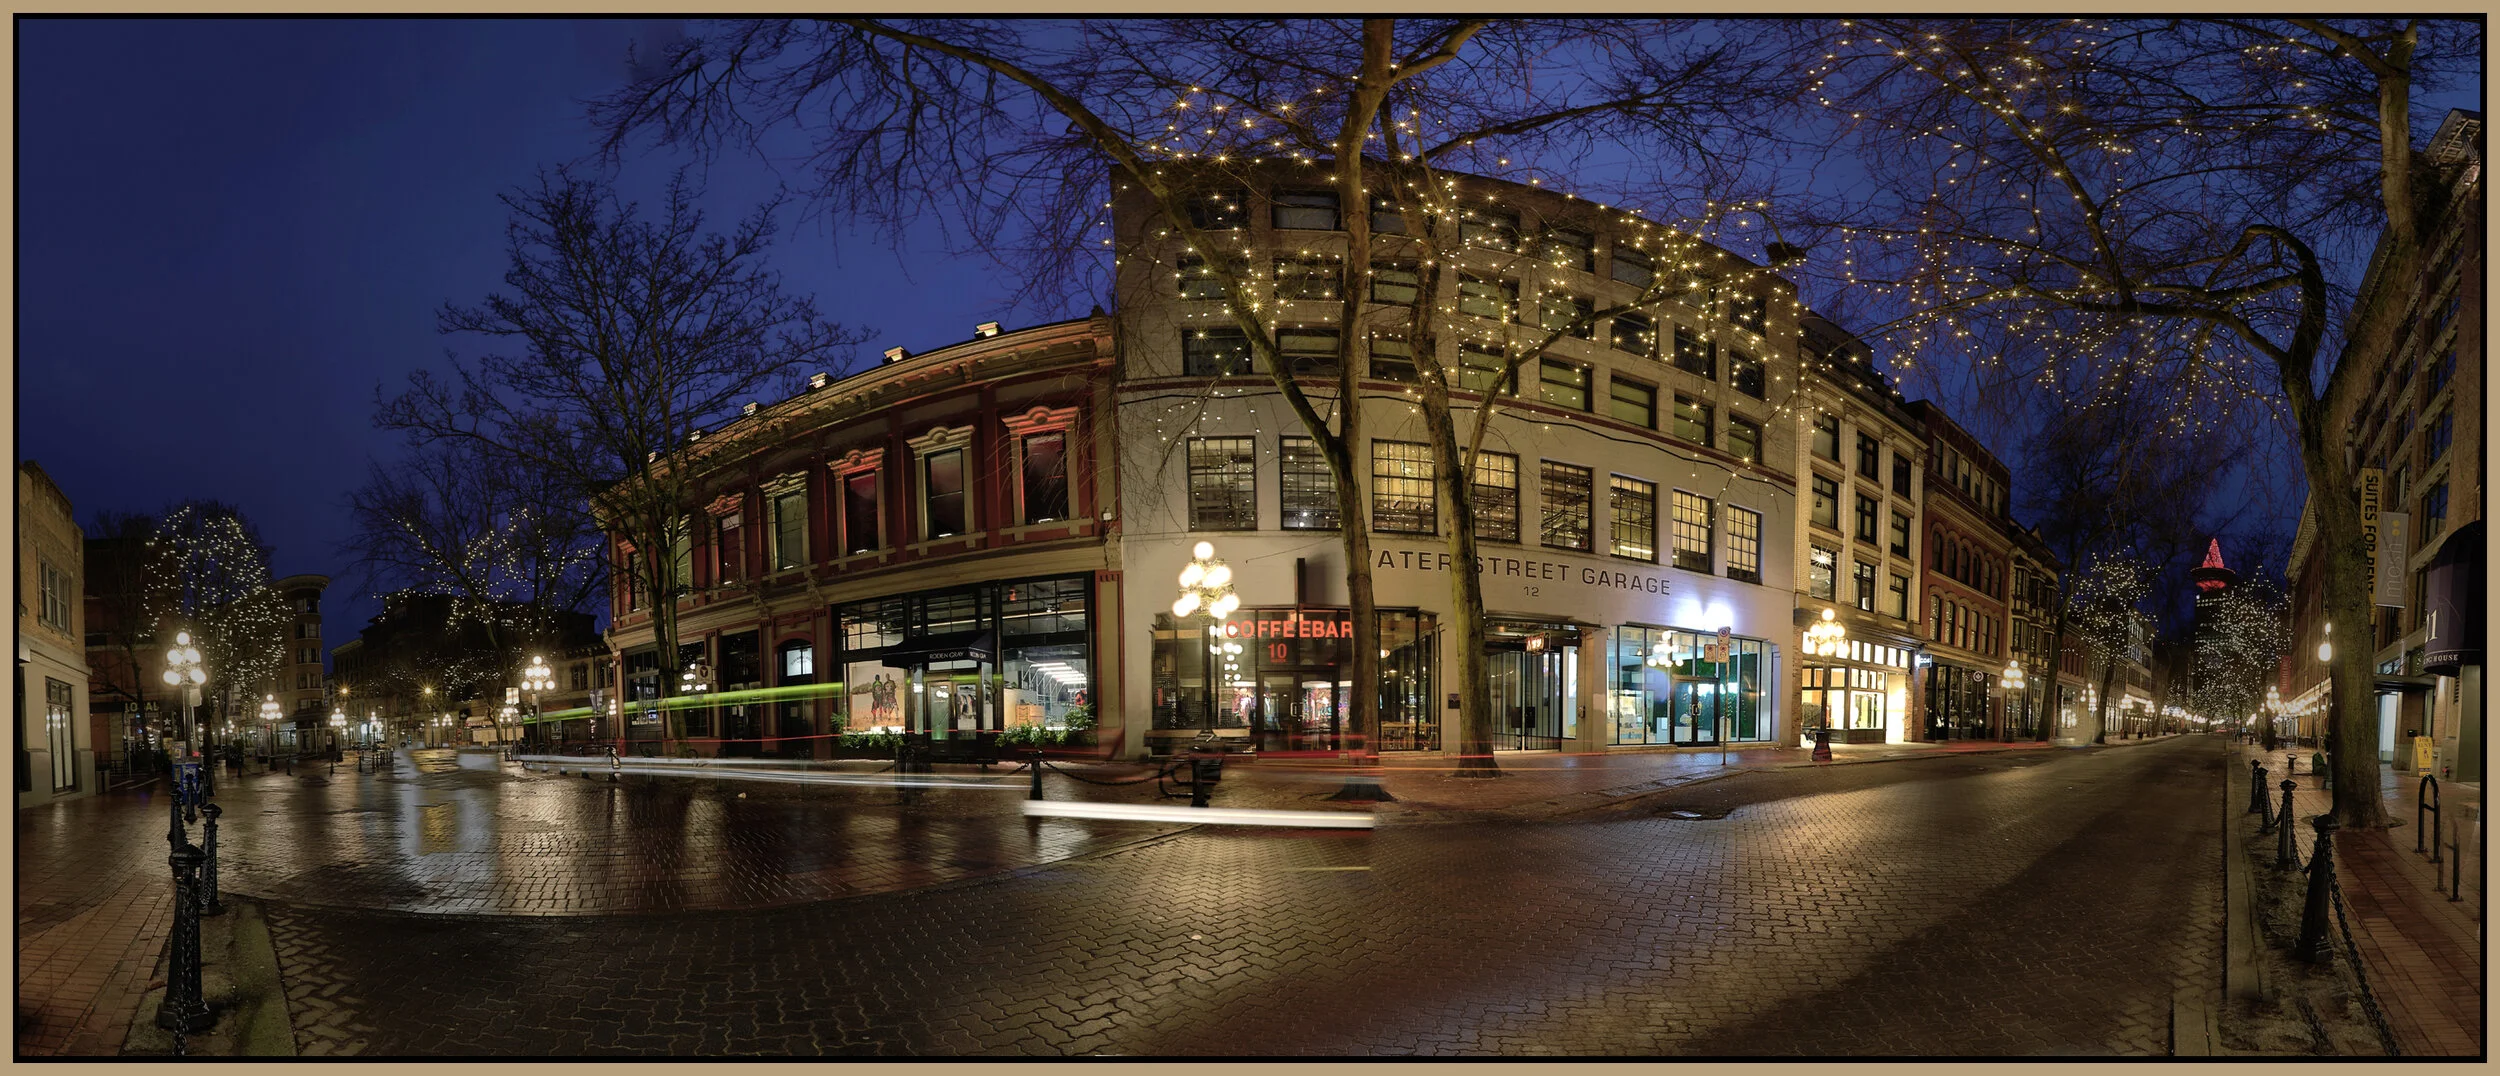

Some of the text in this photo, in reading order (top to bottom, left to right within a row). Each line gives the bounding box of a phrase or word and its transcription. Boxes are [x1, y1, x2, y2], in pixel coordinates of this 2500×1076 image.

[2364, 476, 2378, 521] SUITES
[2363, 525, 2377, 553] FOR
[1369, 550, 1451, 571] ATER
[1582, 567, 1671, 595] GARAGE
[1523, 586, 1539, 597] 12
[1226, 620, 1353, 639] COFFEEBAR
[1267, 643, 1287, 658] 10
[2433, 654, 2459, 663] HOUSE
[124, 701, 160, 713] LOAL
